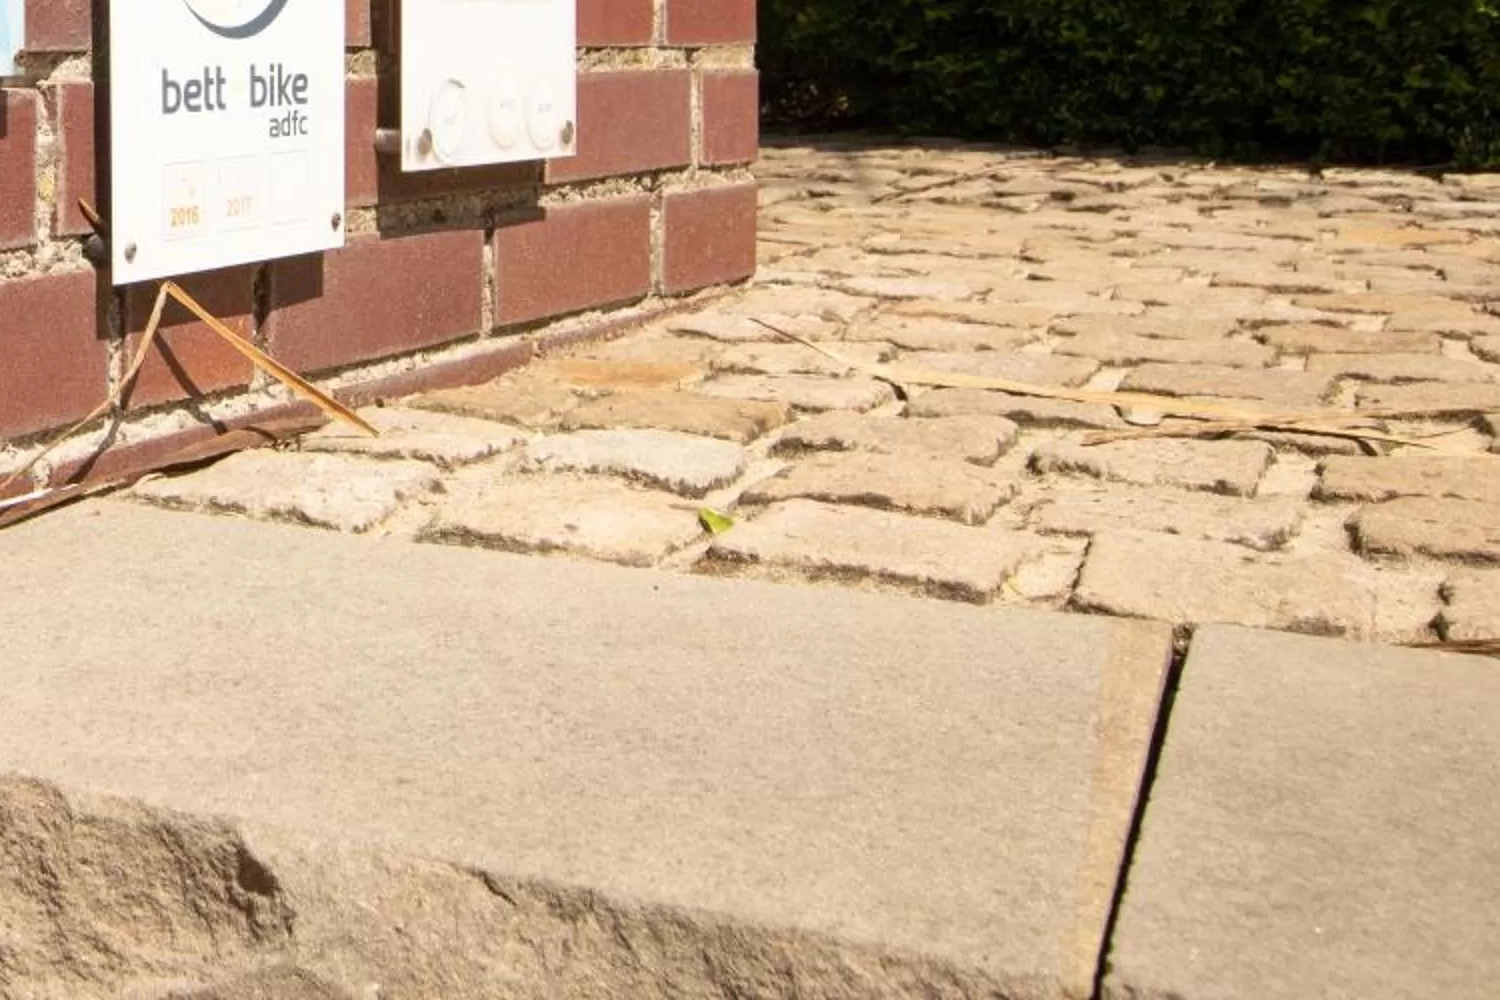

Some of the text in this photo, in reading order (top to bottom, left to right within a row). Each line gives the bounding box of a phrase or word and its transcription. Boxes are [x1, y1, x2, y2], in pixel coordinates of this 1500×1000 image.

[161, 62, 309, 114] bett bike
[268, 109, 308, 138] adfc
